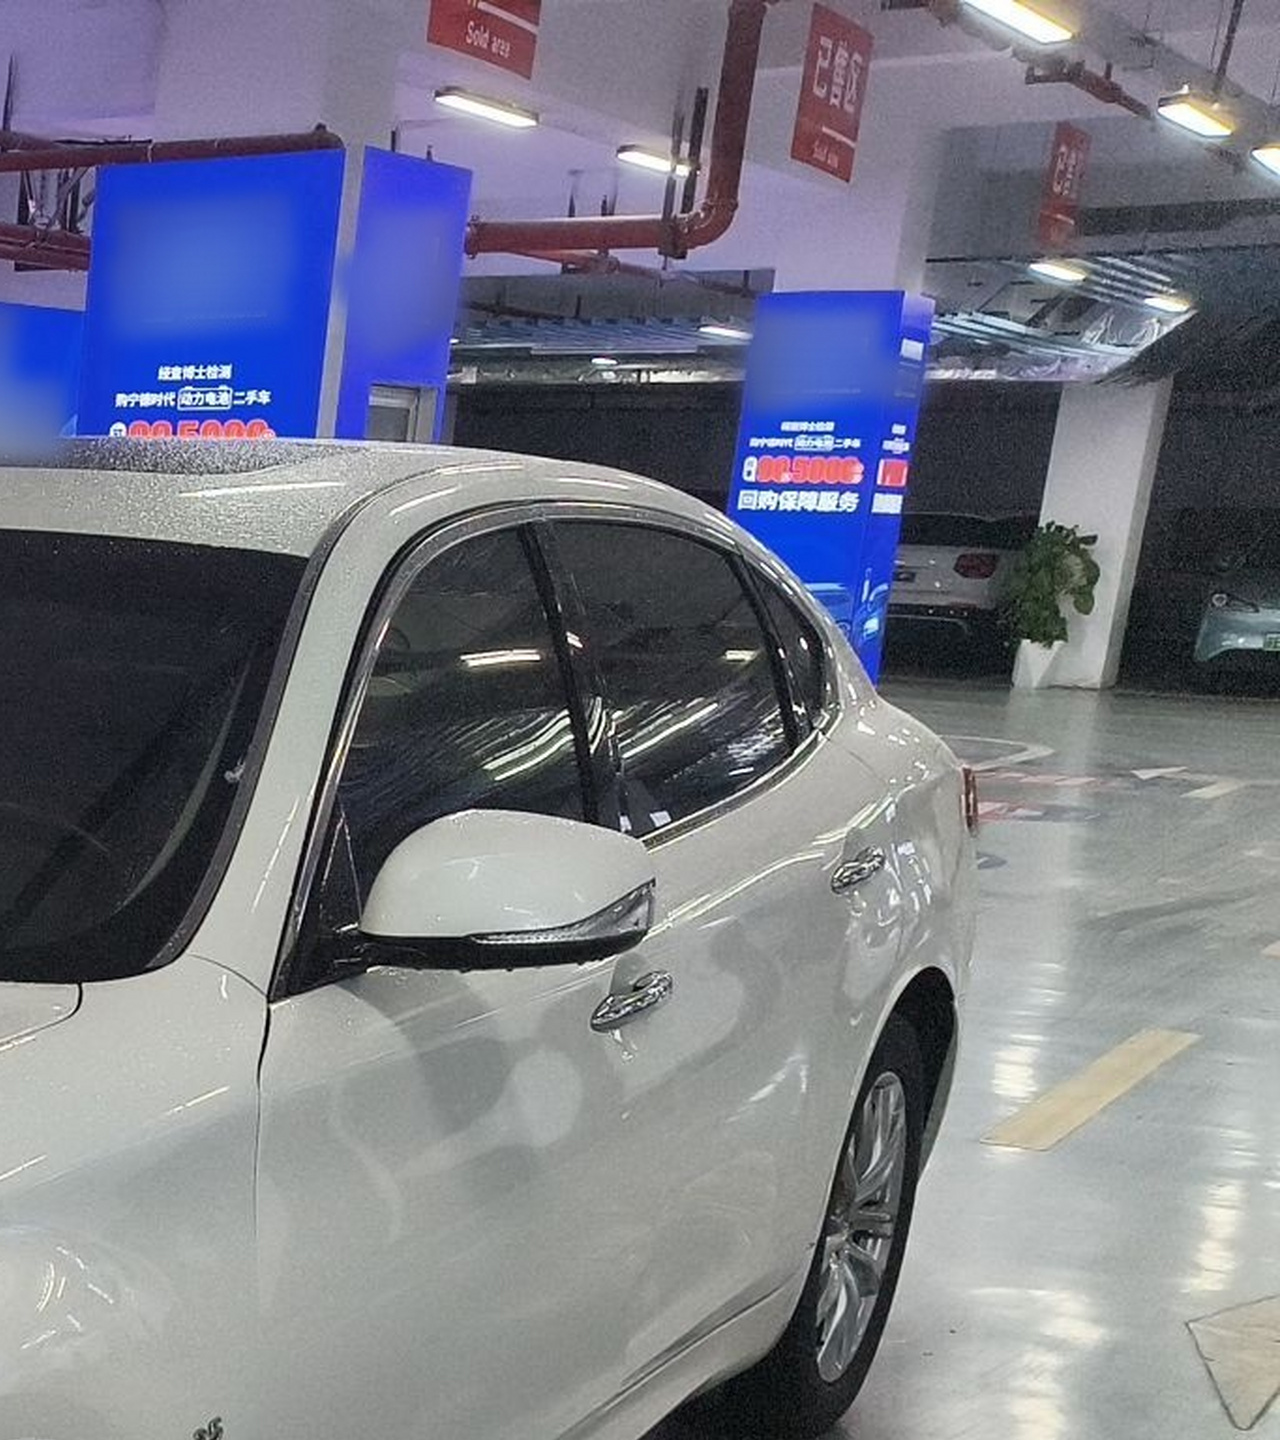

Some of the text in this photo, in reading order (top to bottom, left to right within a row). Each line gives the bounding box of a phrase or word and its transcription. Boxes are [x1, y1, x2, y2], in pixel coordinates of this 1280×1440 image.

[466, 20, 490, 49] Sold
[813, 35, 863, 114] 已售区
[233, 390, 271, 406] 二手车
